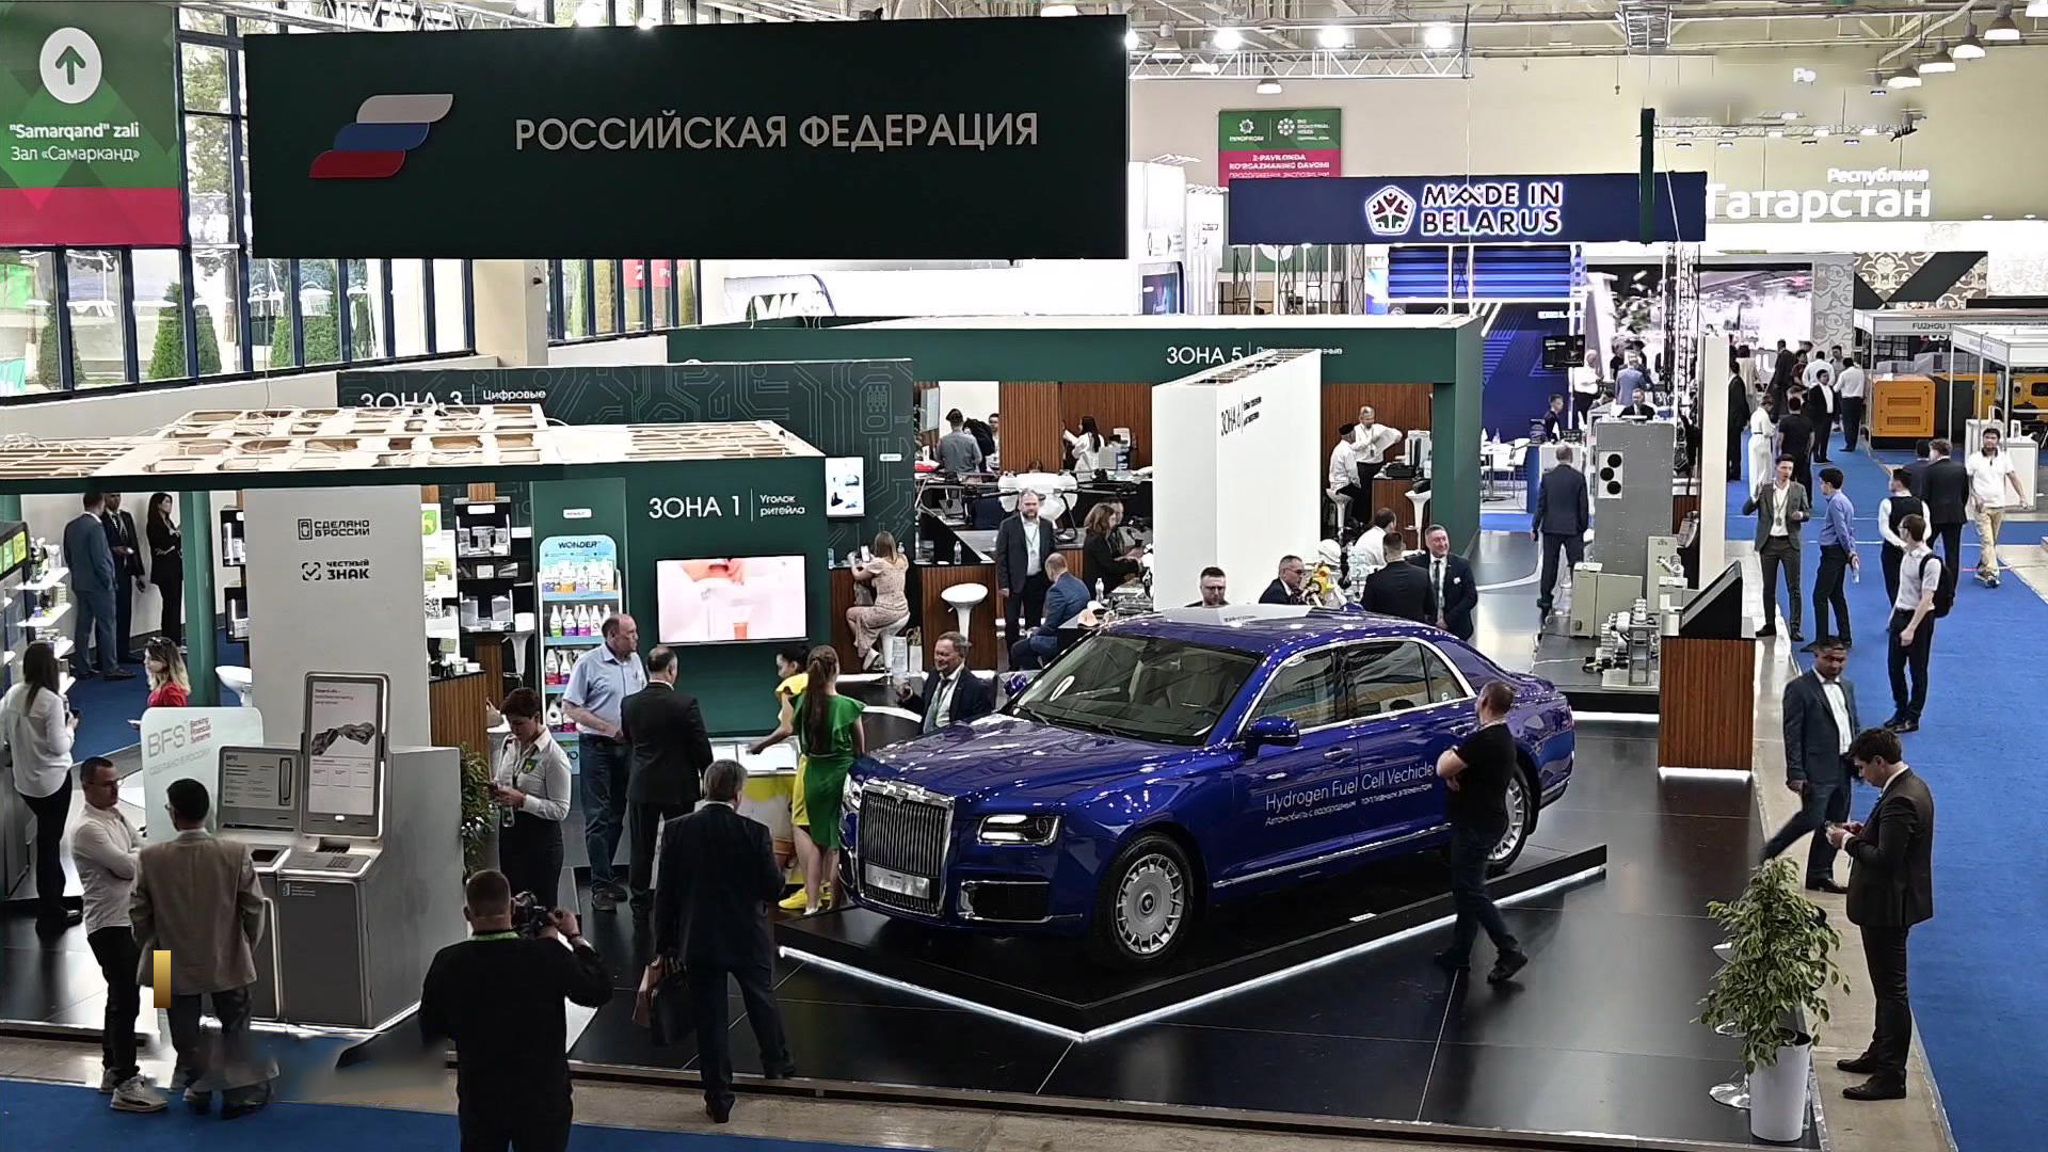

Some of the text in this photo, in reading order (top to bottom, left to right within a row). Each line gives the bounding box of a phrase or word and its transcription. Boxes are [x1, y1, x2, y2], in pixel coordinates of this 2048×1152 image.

[9, 122, 140, 141] "Samarqand" zali
[515, 109, 1038, 153] РОССИЙСКАЯ ФЕДЕРАЦИЯ
[11, 145, 140, 163] Зал «Самарканд»
[1827, 167, 1929, 186] Республика
[1423, 183, 1562, 207] MADE IN
[1422, 210, 1562, 235] BELARUS
[1167, 346, 1225, 365] ЗОНА
[1231, 347, 1243, 362] 5
[360, 391, 464, 408] ЗОНА 3
[483, 388, 547, 402] Цифровые
[649, 495, 740, 519] ЗОНА 1
[760, 494, 796, 505] Уголок
[760, 505, 805, 518] ритейла
[314, 520, 370, 529] СДЕЛАНО
[326, 559, 370, 567] ЧЕСТНЫЙ
[327, 568, 370, 580] ЗНАК
[147, 724, 187, 758] BFS
[1266, 761, 1434, 814] Hydrogen Fuel Cell Vechicle
